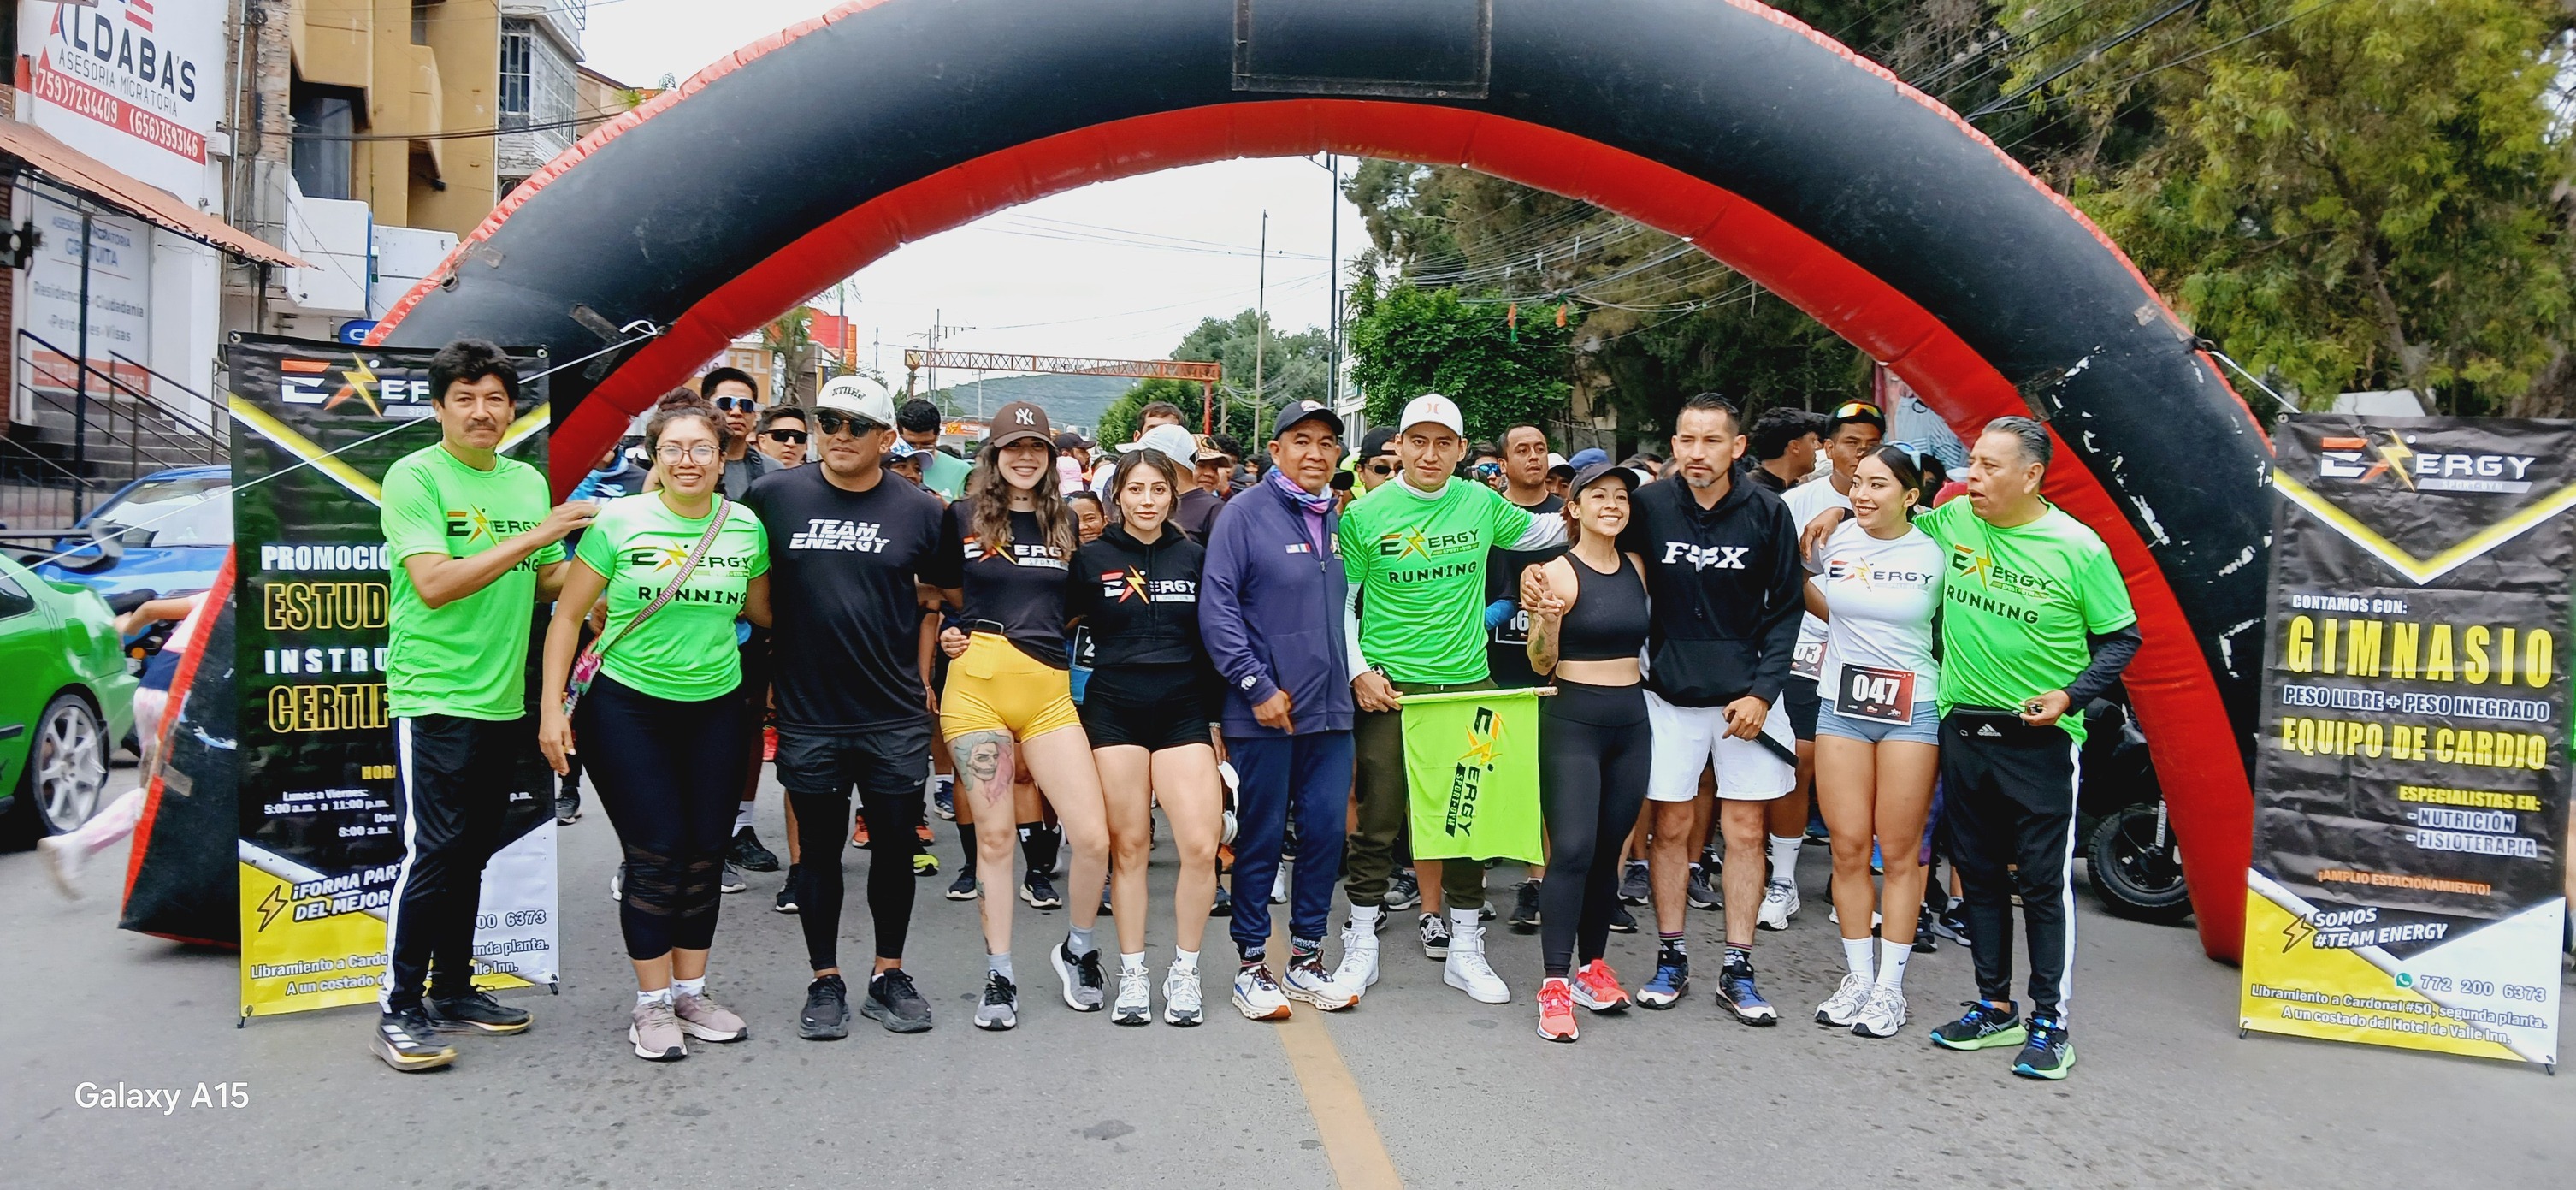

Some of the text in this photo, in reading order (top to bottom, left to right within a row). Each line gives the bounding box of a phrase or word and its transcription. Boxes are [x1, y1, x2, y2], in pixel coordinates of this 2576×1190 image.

[38, 68, 198, 157] 759)7234409 (656)3593146
[808, 518, 881, 537] TEAM
[789, 533, 890, 554] ENERGY
[1388, 560, 1477, 583] RUNNING
[1947, 584, 2039, 624] RUNNING
[2292, 594, 2408, 614] CONTAMOS CON:
[2288, 615, 2553, 688] GIMNASIO
[1852, 673, 1900, 706] 047
[2283, 685, 2551, 723] PESO LIBRE + PESO INEGRADO
[2282, 717, 2547, 770] EQUIPO DE CARDIO
[264, 799, 389, 814] 5:00 a.m. a 11:00 p.m.
[282, 791, 316, 802] Lunes
[2399, 785, 2542, 812] ESPECIALISTAS EN:
[338, 790, 533, 837] 8:00 a.m. p.m.
[2318, 870, 2491, 896] ¡AMPLIO ESTACIONAMIENTO!
[294, 890, 390, 921] DEL MEJOR
[505, 909, 547, 927] 6373
[2314, 908, 2378, 927] SOMOS
[2314, 923, 2448, 948] #TEAM ENERGY
[251, 959, 334, 979] Libramiento
[336, 958, 346, 968] a
[504, 938, 549, 956] planta.
[286, 982, 297, 996] A
[299, 981, 316, 994] un
[319, 974, 375, 991] costado
[493, 961, 518, 974] Inn.
[2421, 974, 2546, 1002] 772 200 6373
[2251, 984, 2548, 1028] Libramiento a Cardonal #50, segunda planta.
[2281, 1005, 2512, 1045] A un costado del Hotel de Valle Inn.
